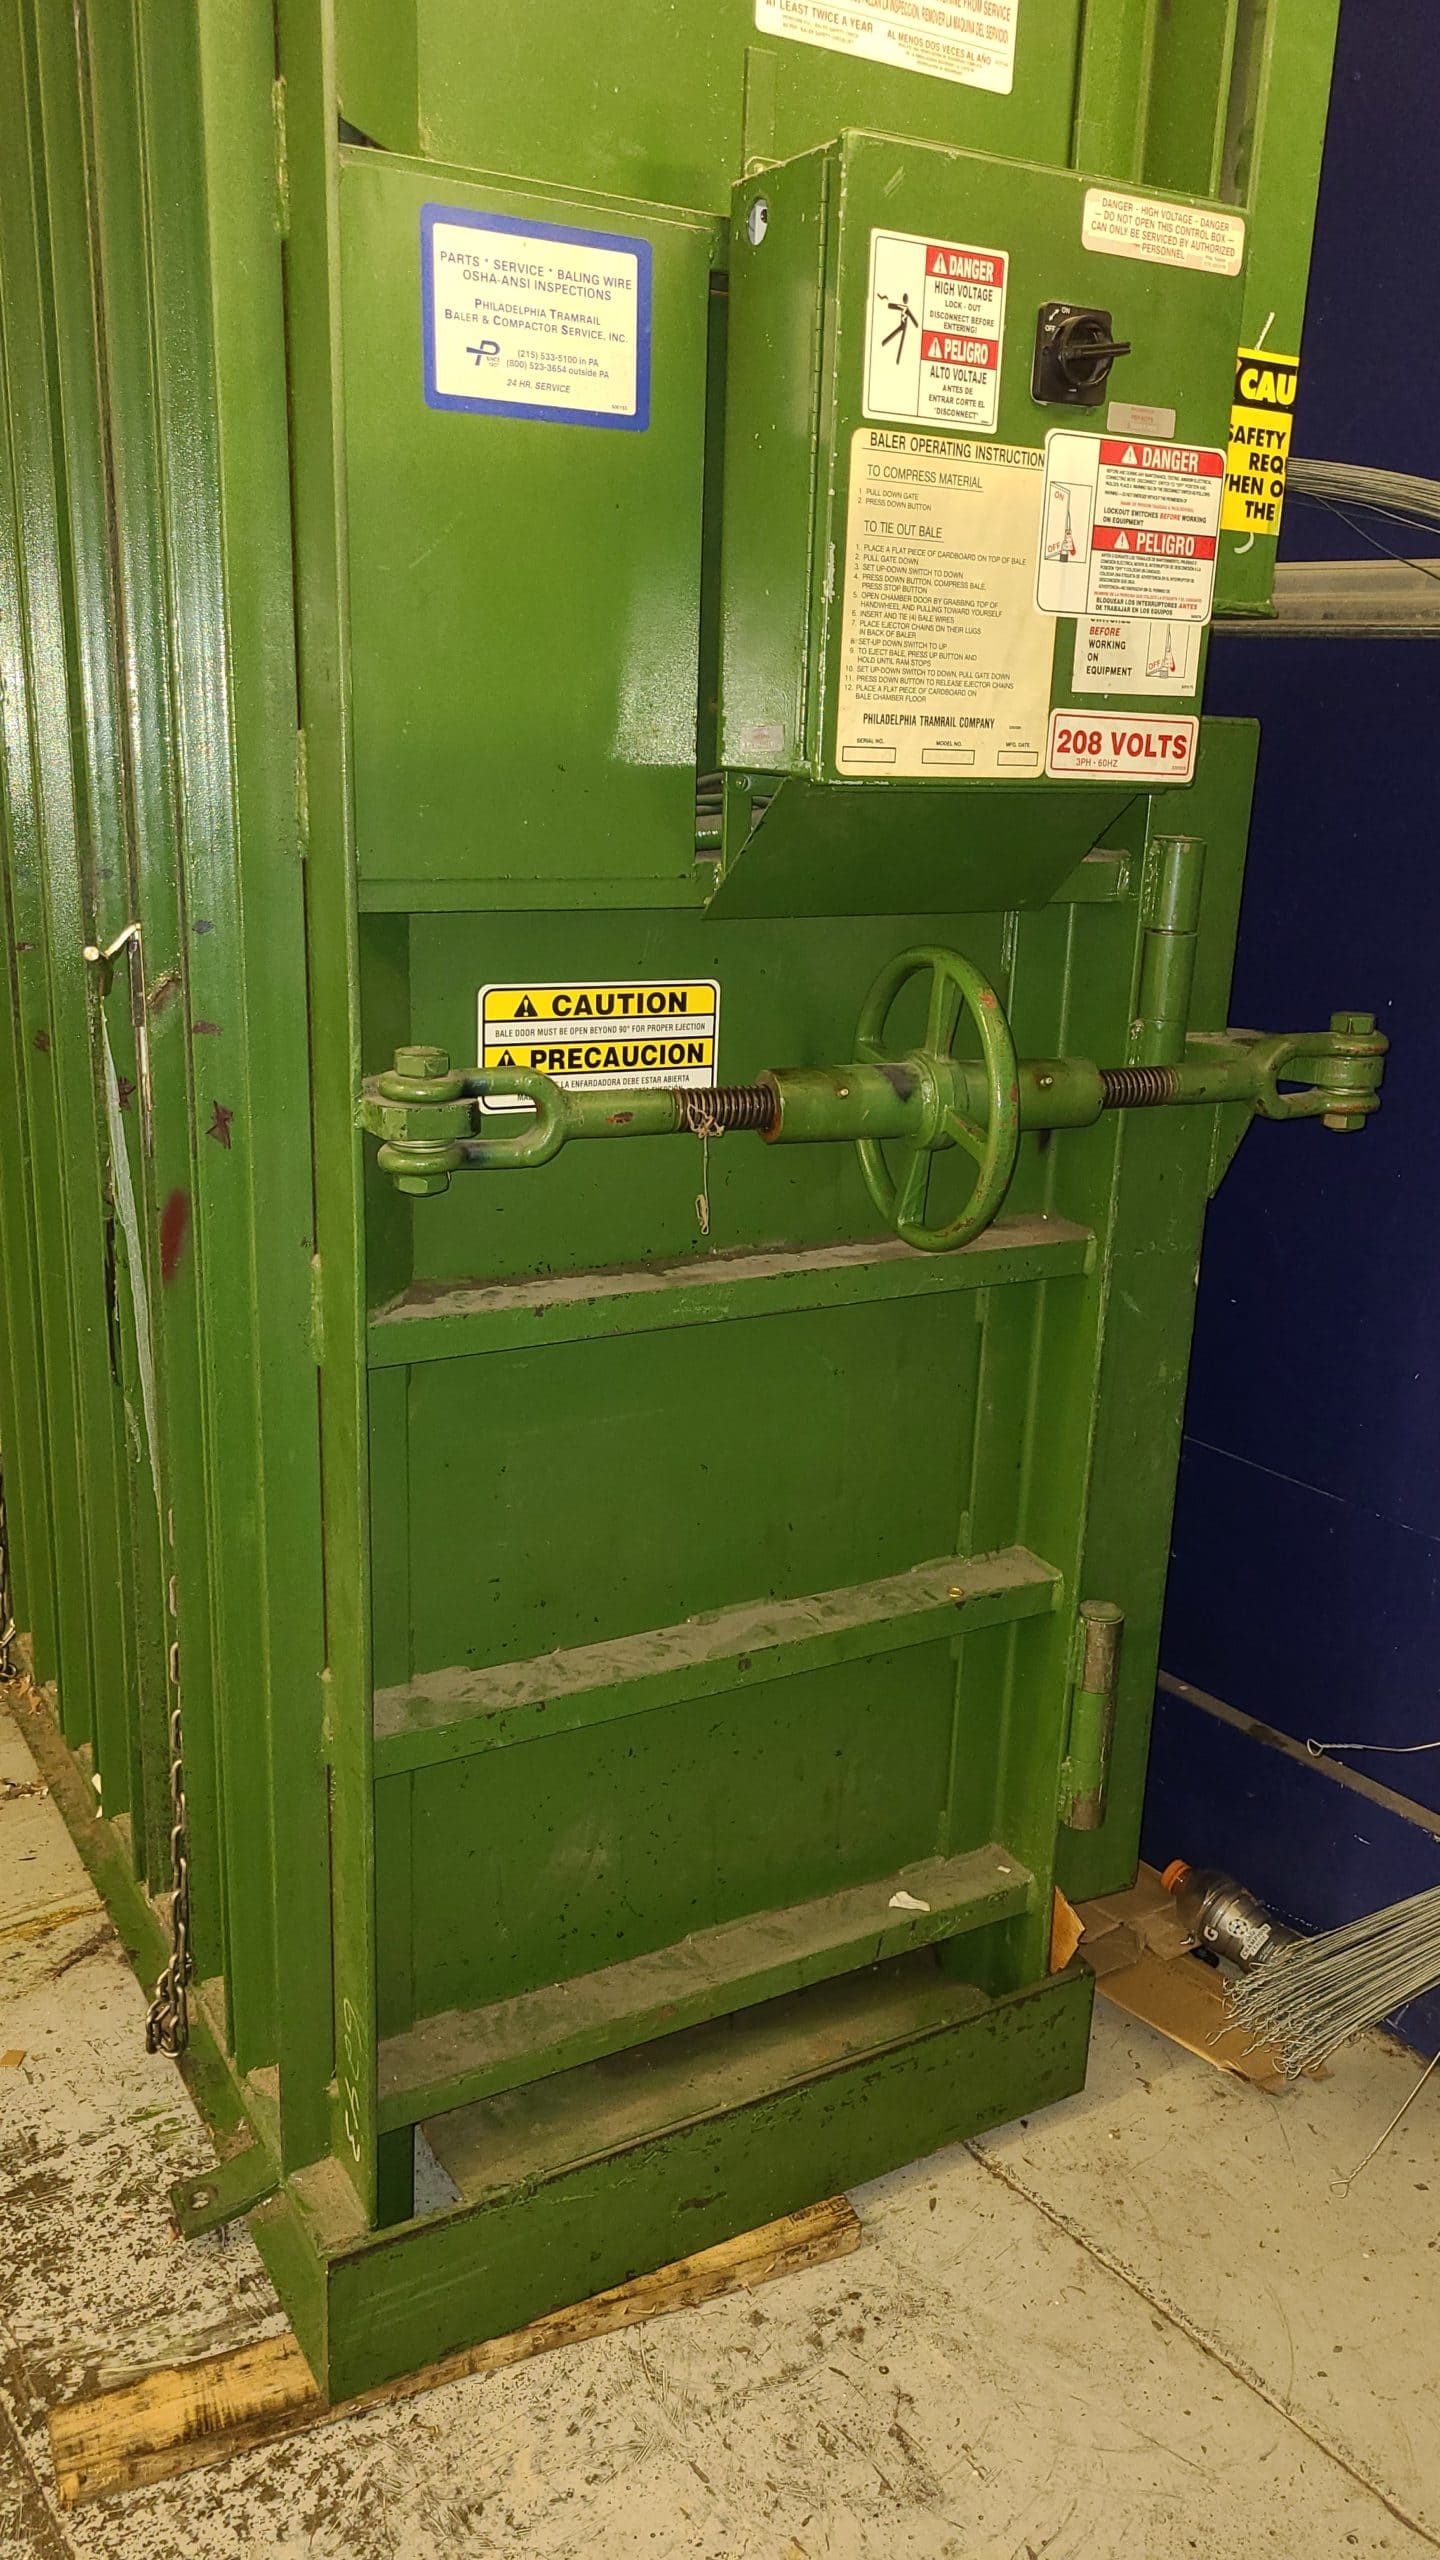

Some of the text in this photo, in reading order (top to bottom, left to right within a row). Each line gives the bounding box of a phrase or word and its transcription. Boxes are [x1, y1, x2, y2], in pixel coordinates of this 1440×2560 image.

[780, 0, 808, 16] LEAST
[812, 7, 839, 24] TWICE
[842, 16, 847, 26] A
[850, 19, 873, 32] YEAR
[984, 3, 1011, 22] SERVICE
[888, 30, 896, 40] AL
[899, 32, 924, 47] MENOS
[925, 40, 940, 52] DOS
[942, 44, 965, 58] VECES
[966, 51, 975, 61] AL
[977, 52, 992, 65] AÑO
[1102, 197, 1230, 232] DANGER HIGH VOLTAGE DANGER
[1103, 210, 1226, 243] DO NOT OPEN THIS CONTROL BOX
[1091, 220, 1235, 257] CAN ONLY BE SERVICED BY AUTHORIZED
[1141, 243, 1185, 260] PERSONNEL
[440, 251, 632, 290] PARTS SERVICE BALING WIRE
[949, 255, 994, 282] DANGER
[463, 270, 612, 301] OSHA-ANSI INSPECTIONS
[934, 281, 993, 302] HIGH VOLTAGE
[474, 299, 600, 325] PHILADELPHIA TRAMRAIL
[945, 300, 981, 312] LOCK OUT
[445, 309, 478, 322] BALER
[482, 315, 489, 324] &
[493, 315, 558, 333] COMPACTOR
[609, 332, 628, 343] INC.
[929, 310, 994, 327] DISCONNECT BEFORE
[517, 349, 599, 367] (215) 533-5100 in PA
[944, 338, 989, 364] PELIGRO
[506, 359, 527, 370] (800)
[568, 365, 597, 378] outside
[599, 369, 609, 378] PA
[930, 366, 987, 384] ALTO VOLTAJE
[507, 379, 517, 387] 24
[535, 381, 571, 393] SERVICE
[942, 384, 973, 395] ANTES DE
[1240, 368, 1297, 406] CAU
[928, 394, 954, 404] ENTRAR
[956, 397, 977, 408] CORTE
[870, 432, 905, 450] BALER
[910, 437, 971, 458] OPERATING
[1142, 447, 1199, 473] DANGER
[867, 464, 983, 488] TO COMPRESS MATERIAL
[1225, 473, 1264, 495] HEN
[866, 489, 919, 500] PULL DOWN GATE
[1054, 492, 1065, 501] ON
[866, 498, 885, 506] PRESS
[907, 503, 932, 511] BUTTON
[1244, 500, 1276, 521] THE
[1104, 507, 1207, 524] LOCKOUT SWITCHES BEFORE WORKING
[1112, 517, 1144, 526] EQUIPMENT
[864, 520, 943, 538] TO TIE OUT BALE
[1047, 541, 1060, 553] OFF
[1135, 533, 1195, 555] PELIGRO
[1096, 597, 1124, 606] BLOQUEAR
[1136, 600, 1177, 609] INTERRUPTORES
[1104, 605, 1130, 613] TRABAJAR
[1089, 626, 1121, 637] BEFORE
[1089, 639, 1126, 650] WORKING
[1087, 653, 1098, 662] ON
[1148, 659, 1160, 671] OFF
[1086, 666, 1132, 676] EQUIPMENT
[863, 713, 995, 729] PHILADELPHIA TRAMRAIL COMPANY
[1057, 729, 1188, 759] 208 VOLTS
[1076, 757, 1119, 768] 3PH 60HZ
[551, 991, 688, 1016] CAUTION
[495, 1028, 513, 1038] BALE
[515, 1028, 535, 1037] DOOR
[537, 1027, 557, 1036] MUST
[560, 1027, 568, 1035] BE
[569, 1026, 588, 1035] OPEN
[590, 1024, 618, 1034] BEYOND
[631, 1024, 645, 1033] FOR
[647, 1023, 673, 1032] PROPER
[675, 1022, 705, 1031] EJECTION
[530, 1042, 704, 1070] PRECAUCION
[560, 1074, 690, 1089] LA ENFARDADORA DEBE ESTAR ABIERTA
[1203, 1925, 1219, 1942] G
